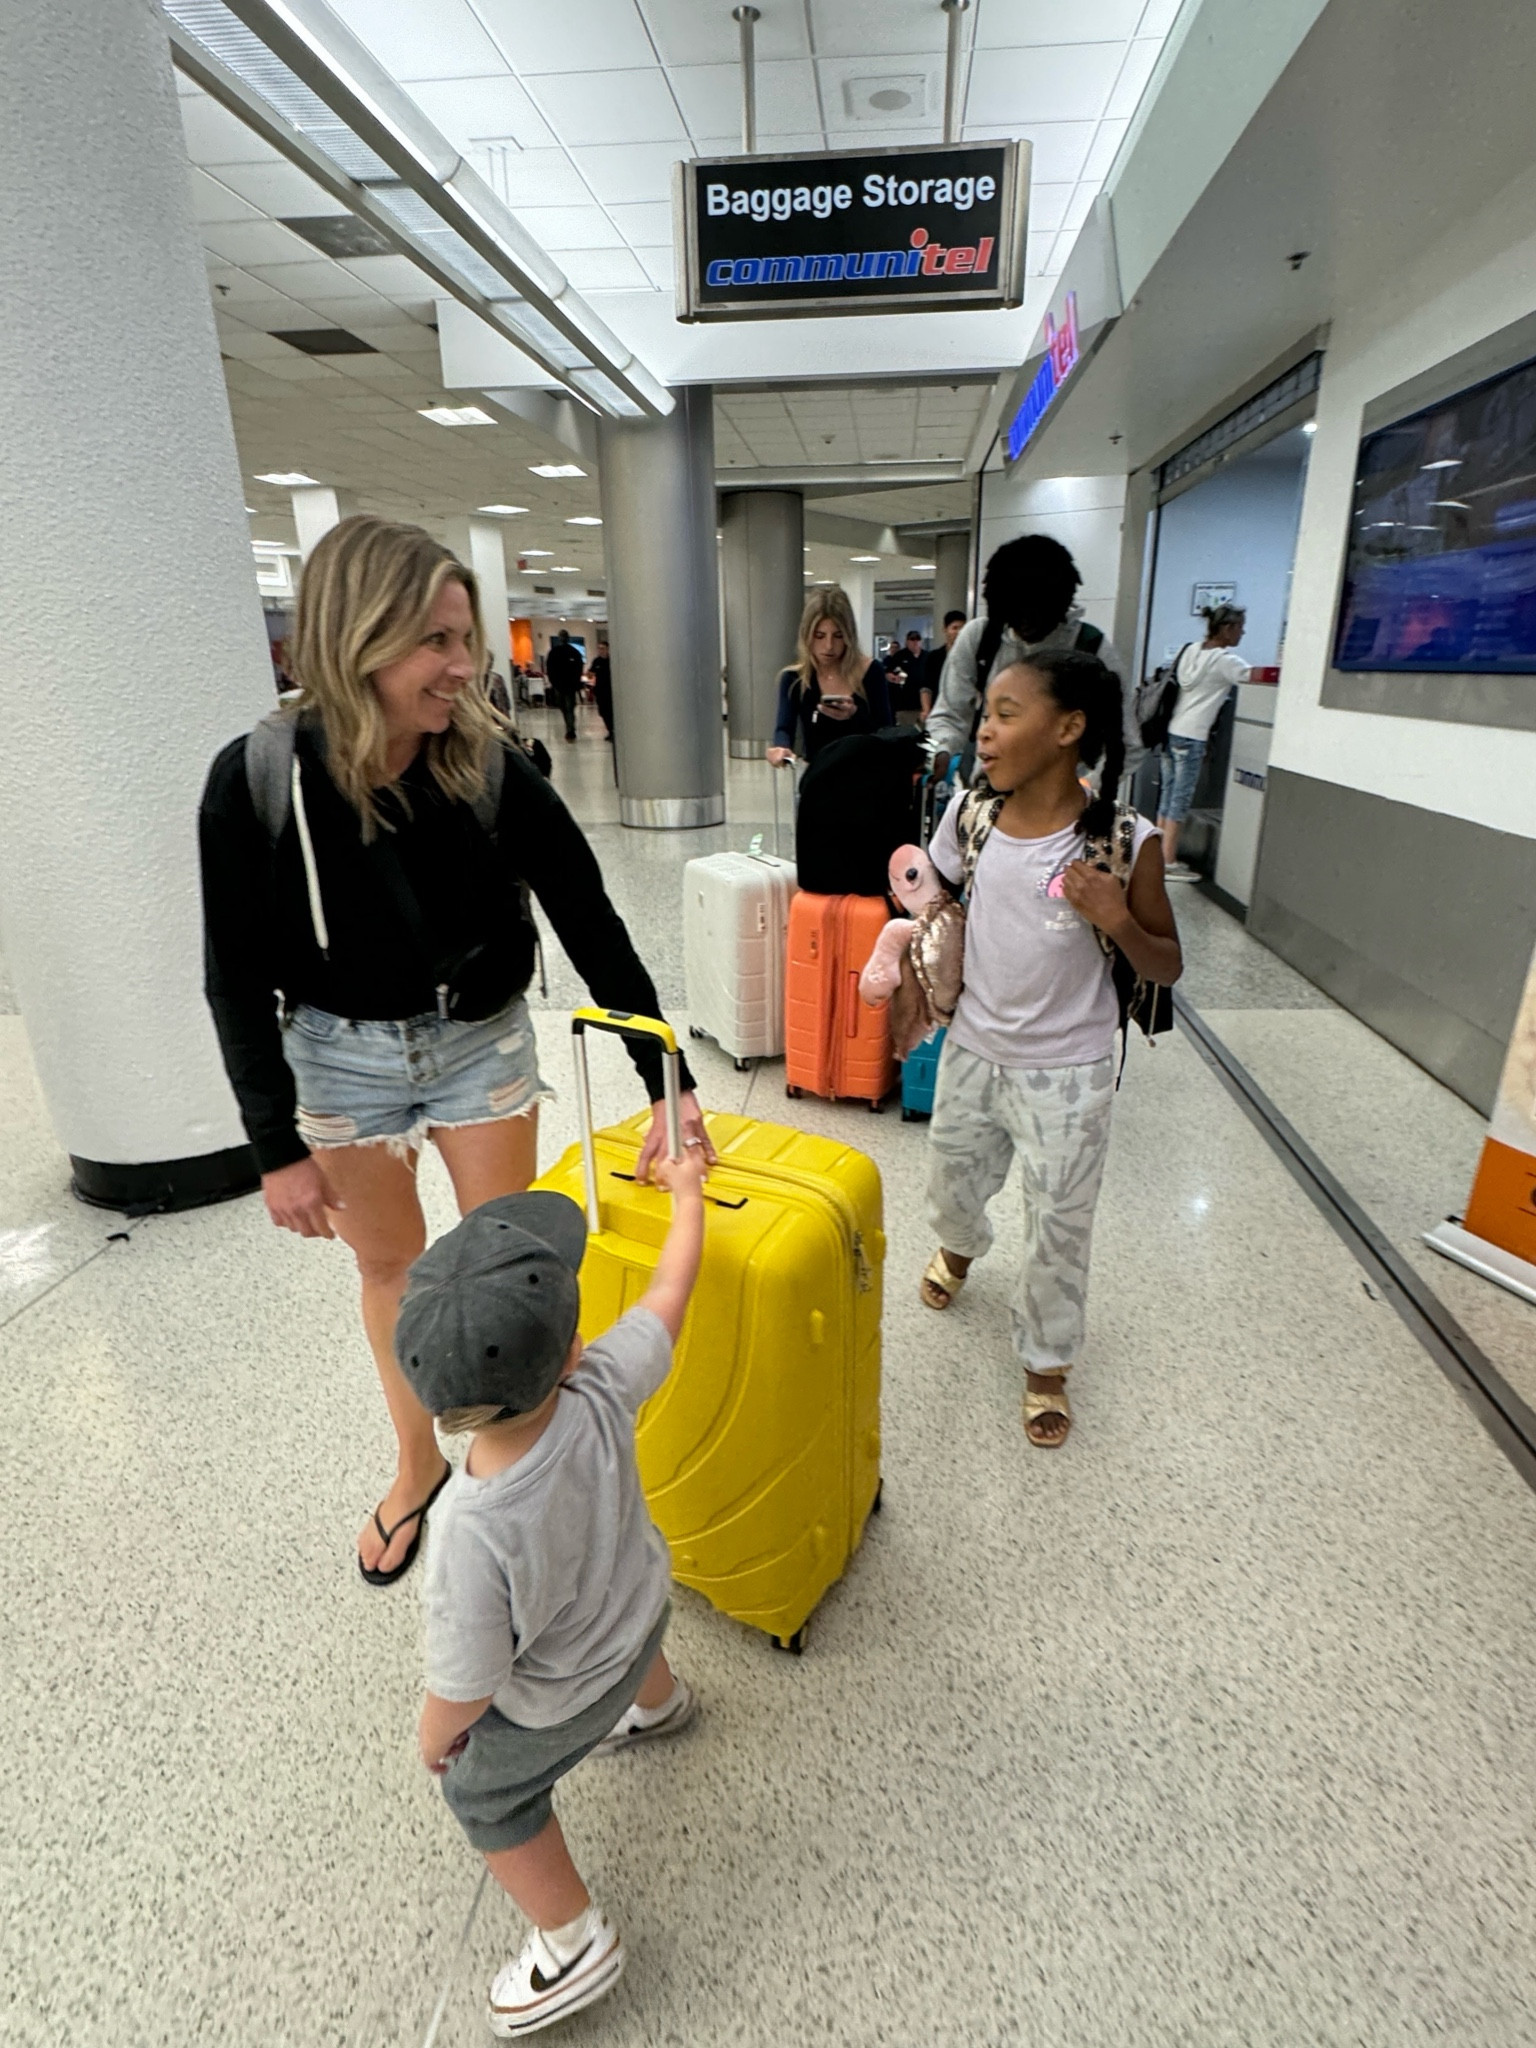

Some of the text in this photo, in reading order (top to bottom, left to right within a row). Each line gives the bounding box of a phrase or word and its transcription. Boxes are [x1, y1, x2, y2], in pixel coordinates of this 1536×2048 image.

[706, 174, 996, 222] Baggage Storage
[706, 227, 995, 286] communitel
